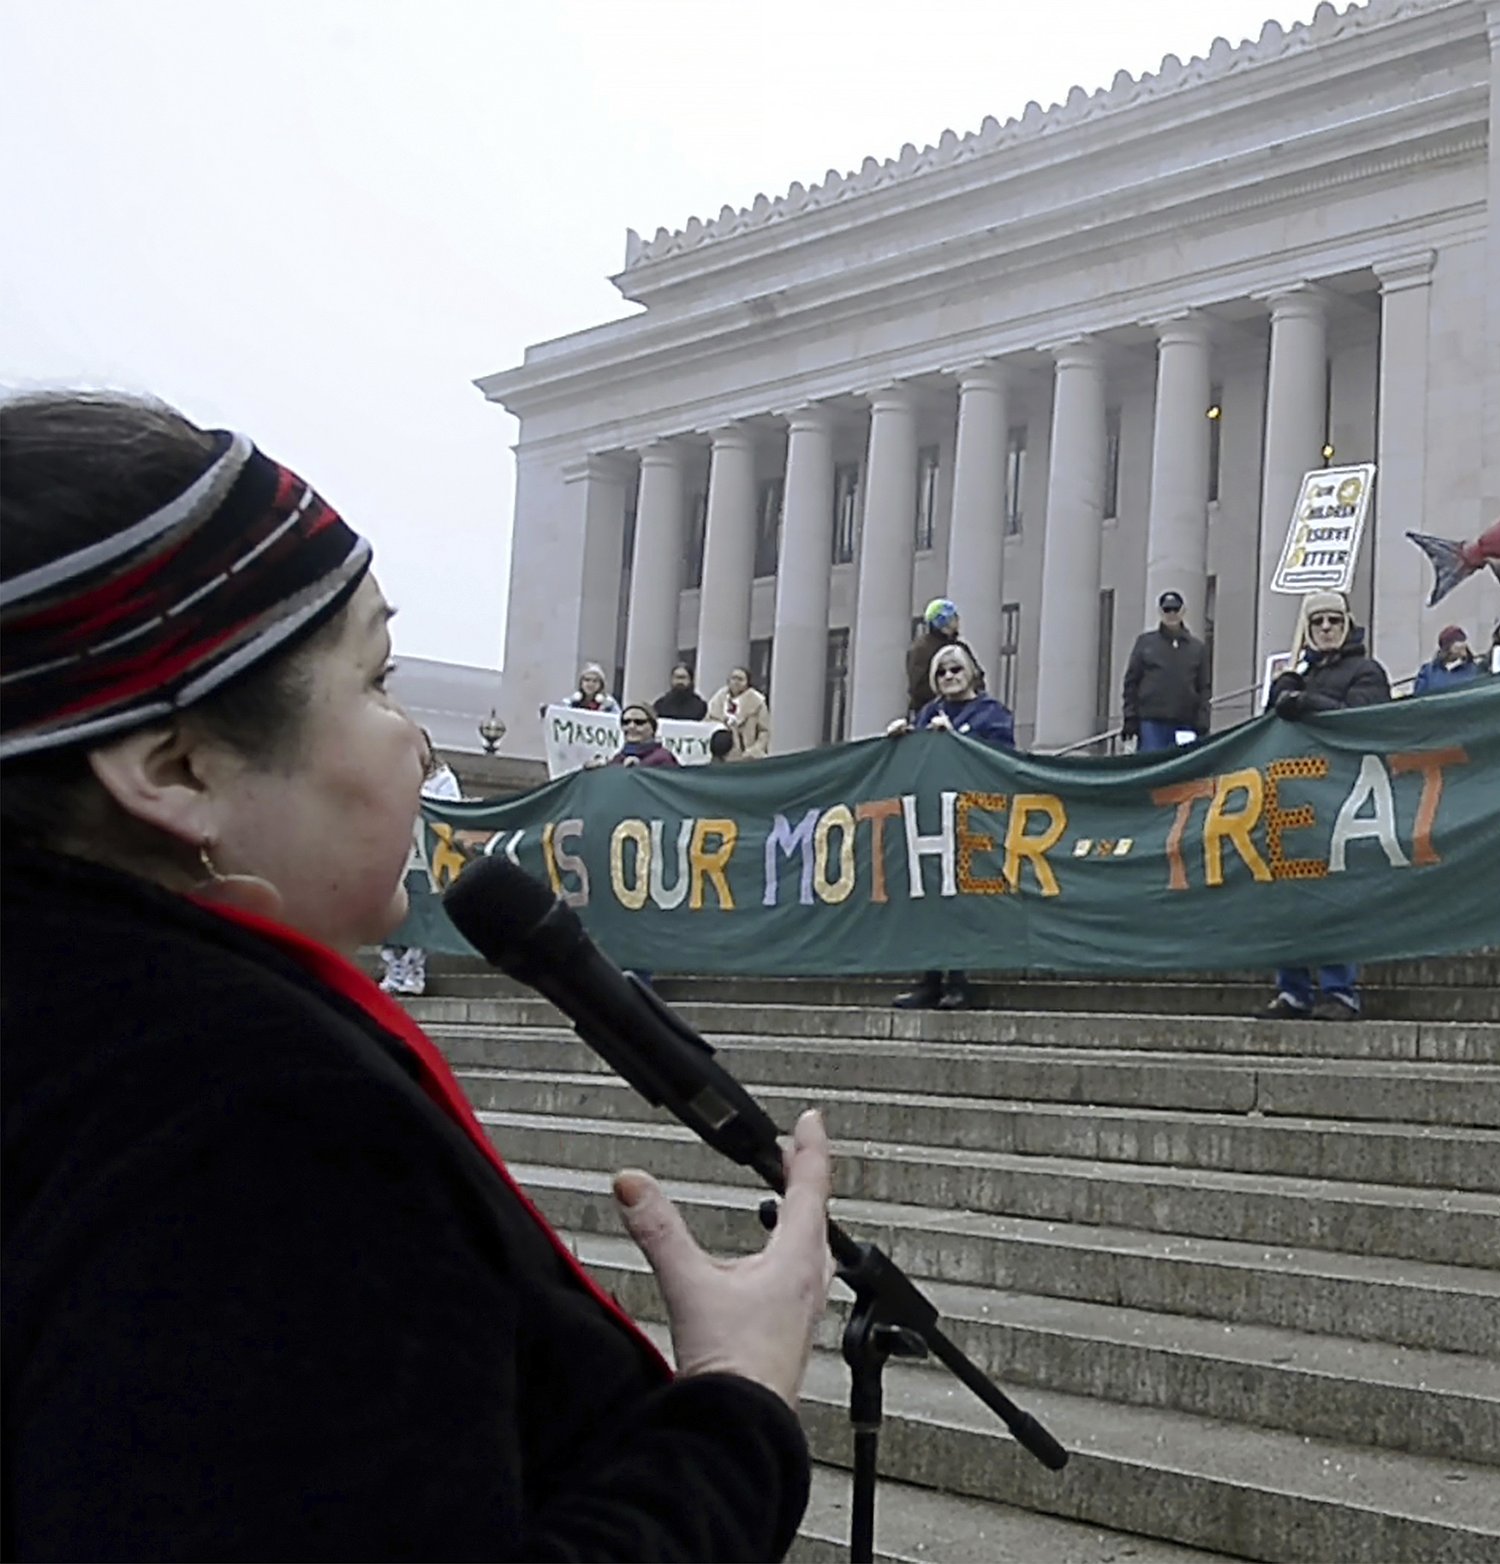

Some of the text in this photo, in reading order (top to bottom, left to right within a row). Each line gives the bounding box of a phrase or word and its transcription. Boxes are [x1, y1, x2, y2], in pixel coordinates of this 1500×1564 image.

[1285, 547, 1350, 569] BETTER
[553, 718, 620, 749] MASON
[543, 819, 590, 907] IS
[610, 818, 739, 911] OUR
[1150, 746, 1469, 891] TREAT
